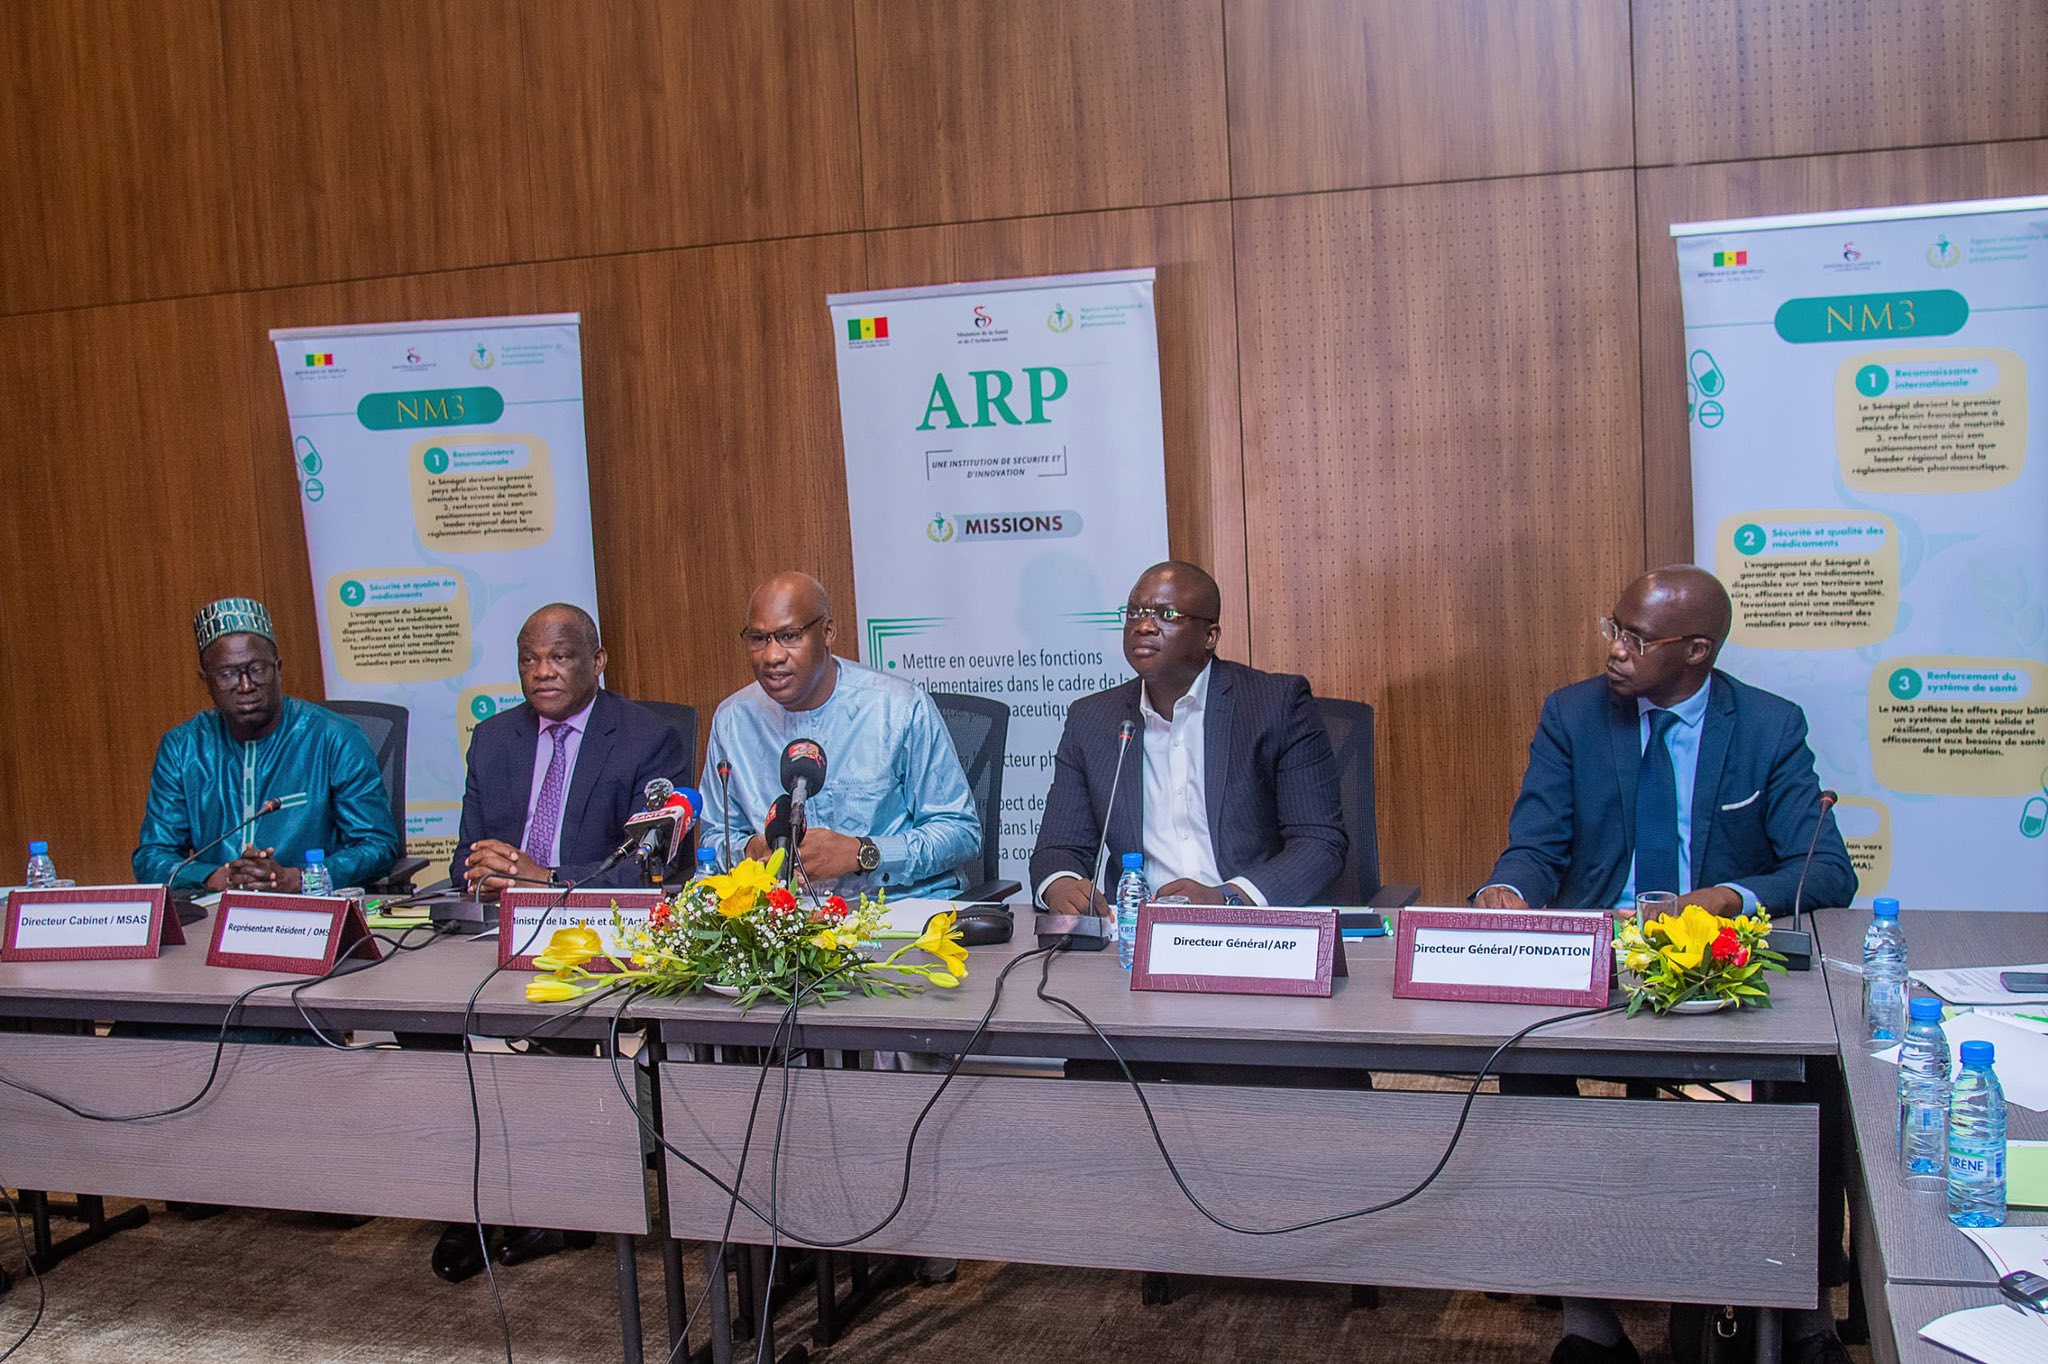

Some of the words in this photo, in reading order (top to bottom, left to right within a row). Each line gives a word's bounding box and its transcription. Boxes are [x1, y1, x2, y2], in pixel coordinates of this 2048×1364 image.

[1827, 299, 1916, 334] NM3
[1895, 367, 1978, 377] Reconnaissance
[1869, 373, 1876, 388] 1
[1896, 379, 1968, 389] internationale
[916, 366, 1068, 430] ARP
[397, 395, 465, 423] NM3
[453, 449, 514, 458] Reconnaissance
[434, 455, 439, 466] 1
[454, 458, 508, 467] internationale
[932, 460, 948, 468] UNE
[950, 457, 998, 467] INSTITUTION
[1001, 456, 1010, 465] DE
[1013, 455, 1050, 464] SECURITE
[968, 468, 1025, 478] D'INNOVATION
[966, 516, 1063, 534] MISSIONS
[1772, 528, 1811, 537] Sécurité
[1828, 527, 1863, 537] qualité
[1867, 526, 1884, 534] des
[1744, 532, 1754, 546] 2
[1772, 540, 1838, 548] médicaments
[1745, 561, 1806, 569] L'engagement
[1825, 559, 1861, 568] Sénégal
[1740, 571, 1776, 579] garantir
[413, 581, 440, 590] qualité
[1732, 581, 1782, 589] disponibles
[348, 587, 357, 599] 2
[371, 592, 422, 600] médicaments
[1851, 590, 1884, 598] qualité,
[1740, 600, 1786, 608] favorisant
[1744, 611, 1792, 619] prévention
[1745, 620, 1785, 628] maladies
[1789, 621, 1810, 629] pour
[1830, 620, 1870, 628] citoyens.
[902, 653, 946, 670] Mettre
[950, 655, 965, 668] en
[969, 653, 1014, 668] oeuvre
[1018, 650, 1037, 666] les
[1040, 649, 1102, 666] fonctions
[1927, 672, 1999, 681] Renforcement
[2002, 672, 2016, 681] du
[1007, 676, 1038, 692] dans
[1042, 674, 1054, 691] le
[1058, 674, 1095, 691] cadre
[1100, 672, 1115, 690] de
[1899, 676, 1910, 690] 3
[1927, 683, 1969, 693] système
[1973, 684, 1985, 692] de
[1990, 684, 2017, 693] santé
[479, 701, 487, 713] 3
[1892, 705, 1915, 713] NM3
[1918, 705, 1948, 713] reflète
[1967, 706, 1998, 714] efforts
[2001, 708, 2023, 716] pour
[1909, 716, 1947, 726] système
[1965, 717, 1990, 725] santé
[1893, 726, 1932, 735] résilient,
[1936, 727, 1973, 735] capable
[1991, 727, 2035, 736] répondre
[1882, 736, 1942, 744] efficacement
[1966, 737, 2001, 746] besoins
[2005, 738, 2017, 746] de
[1950, 747, 2004, 756] population.
[1004, 752, 1036, 768] cteur
[21, 916, 66, 927] Directeur
[69, 914, 108, 926] Cabinet
[110, 915, 114, 925] /
[116, 915, 147, 925] MSAS
[546, 917, 557, 925] de
[560, 917, 567, 925] la
[570, 917, 595, 926] Saté
[598, 918, 606, 926] et
[228, 923, 273, 933] Représentant
[275, 926, 305, 935] Résident
[307, 928, 311, 936] /
[314, 928, 330, 936] OMS
[1174, 936, 1222, 948] Directeur
[1226, 938, 1297, 951] Général/ARP
[1469, 945, 1590, 956] Général/FONDATION
